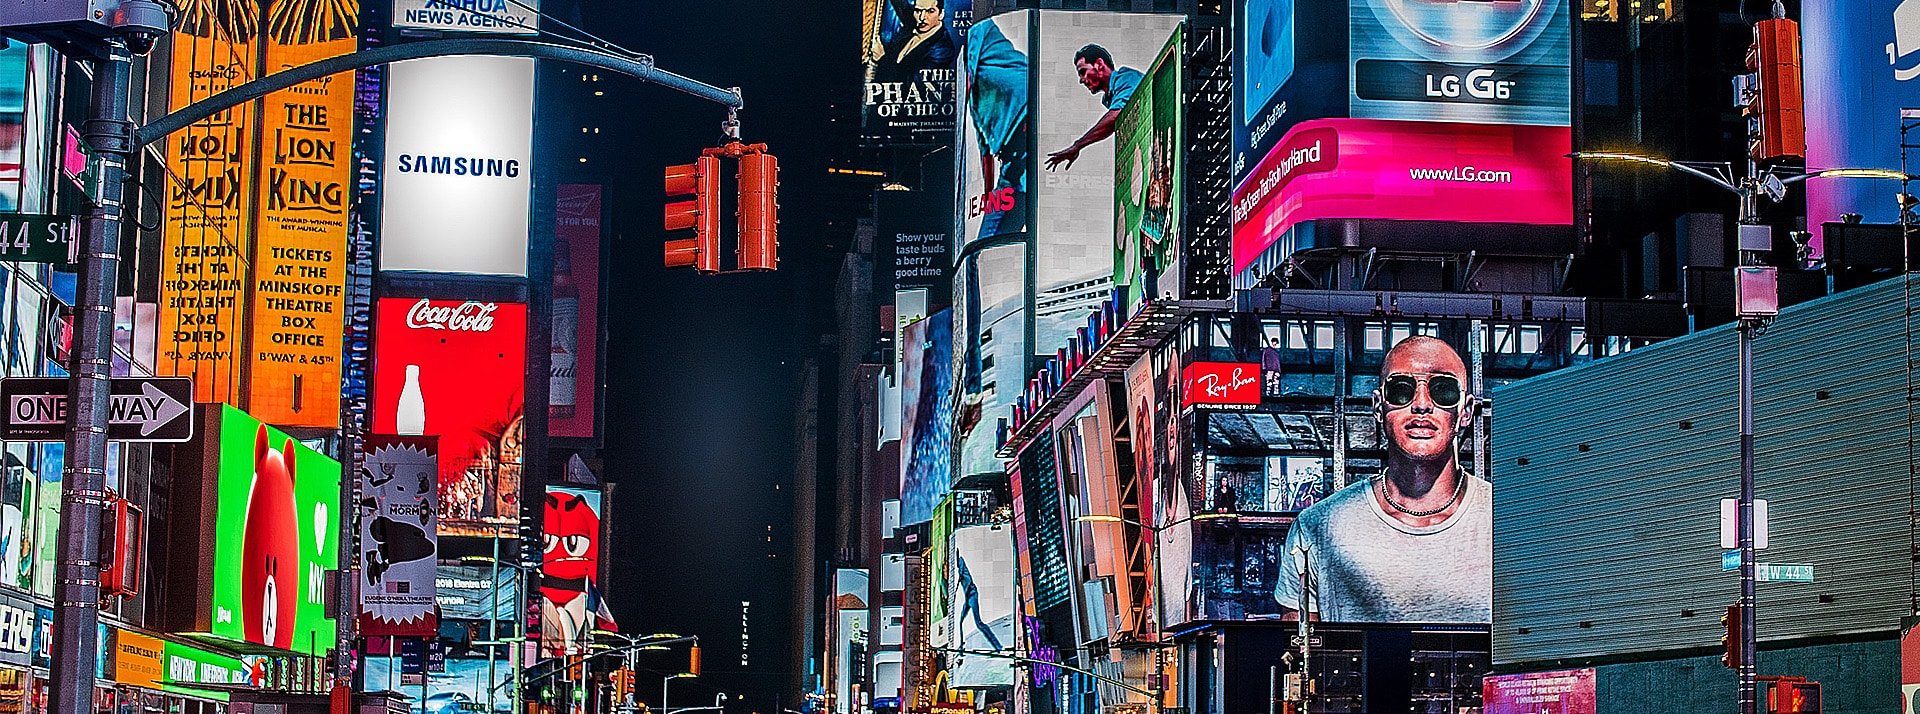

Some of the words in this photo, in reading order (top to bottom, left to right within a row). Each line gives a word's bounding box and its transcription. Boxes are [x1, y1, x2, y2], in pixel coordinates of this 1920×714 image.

[424, 0, 508, 13] XINHUA
[406, 10, 453, 24] NEWS
[458, 14, 526, 28] AGENCY
[920, 69, 955, 81] THE
[1426, 74, 1460, 98] LG
[284, 103, 327, 126] THE
[878, 104, 900, 117] OF
[904, 104, 939, 116] THE
[942, 104, 954, 116] O
[275, 128, 336, 165] LION
[1290, 140, 1320, 168] Hand
[398, 154, 519, 178] SAMSUNG
[1410, 166, 1510, 182] www.LG.com
[268, 167, 342, 211] KING
[968, 187, 1015, 220] JEANS
[282, 217, 342, 227] AWARD-WINNING
[0, 221, 30, 254] 44
[47, 222, 68, 243] St
[896, 234, 922, 242] Show
[923, 233, 945, 243] your
[272, 246, 332, 262] TICKETS
[896, 246, 920, 254] taste
[922, 244, 945, 253] buds
[904, 256, 932, 266] berry
[274, 265, 293, 276] AT
[299, 266, 327, 278] THE
[896, 268, 918, 279] good
[920, 267, 942, 276] time
[258, 280, 341, 297] MINSKOFF
[266, 298, 332, 313] THEATRE
[281, 316, 316, 329] BOX
[272, 333, 324, 346] OFFICE
[260, 352, 296, 363] B'WAY
[299, 354, 308, 364] &
[311, 356, 334, 364] 45TH
[16, 397, 67, 421] ONE
[108, 397, 165, 421] WAY
[390, 507, 436, 516] MORMON
[1770, 566, 1780, 579] W
[1786, 566, 1800, 579] 44
